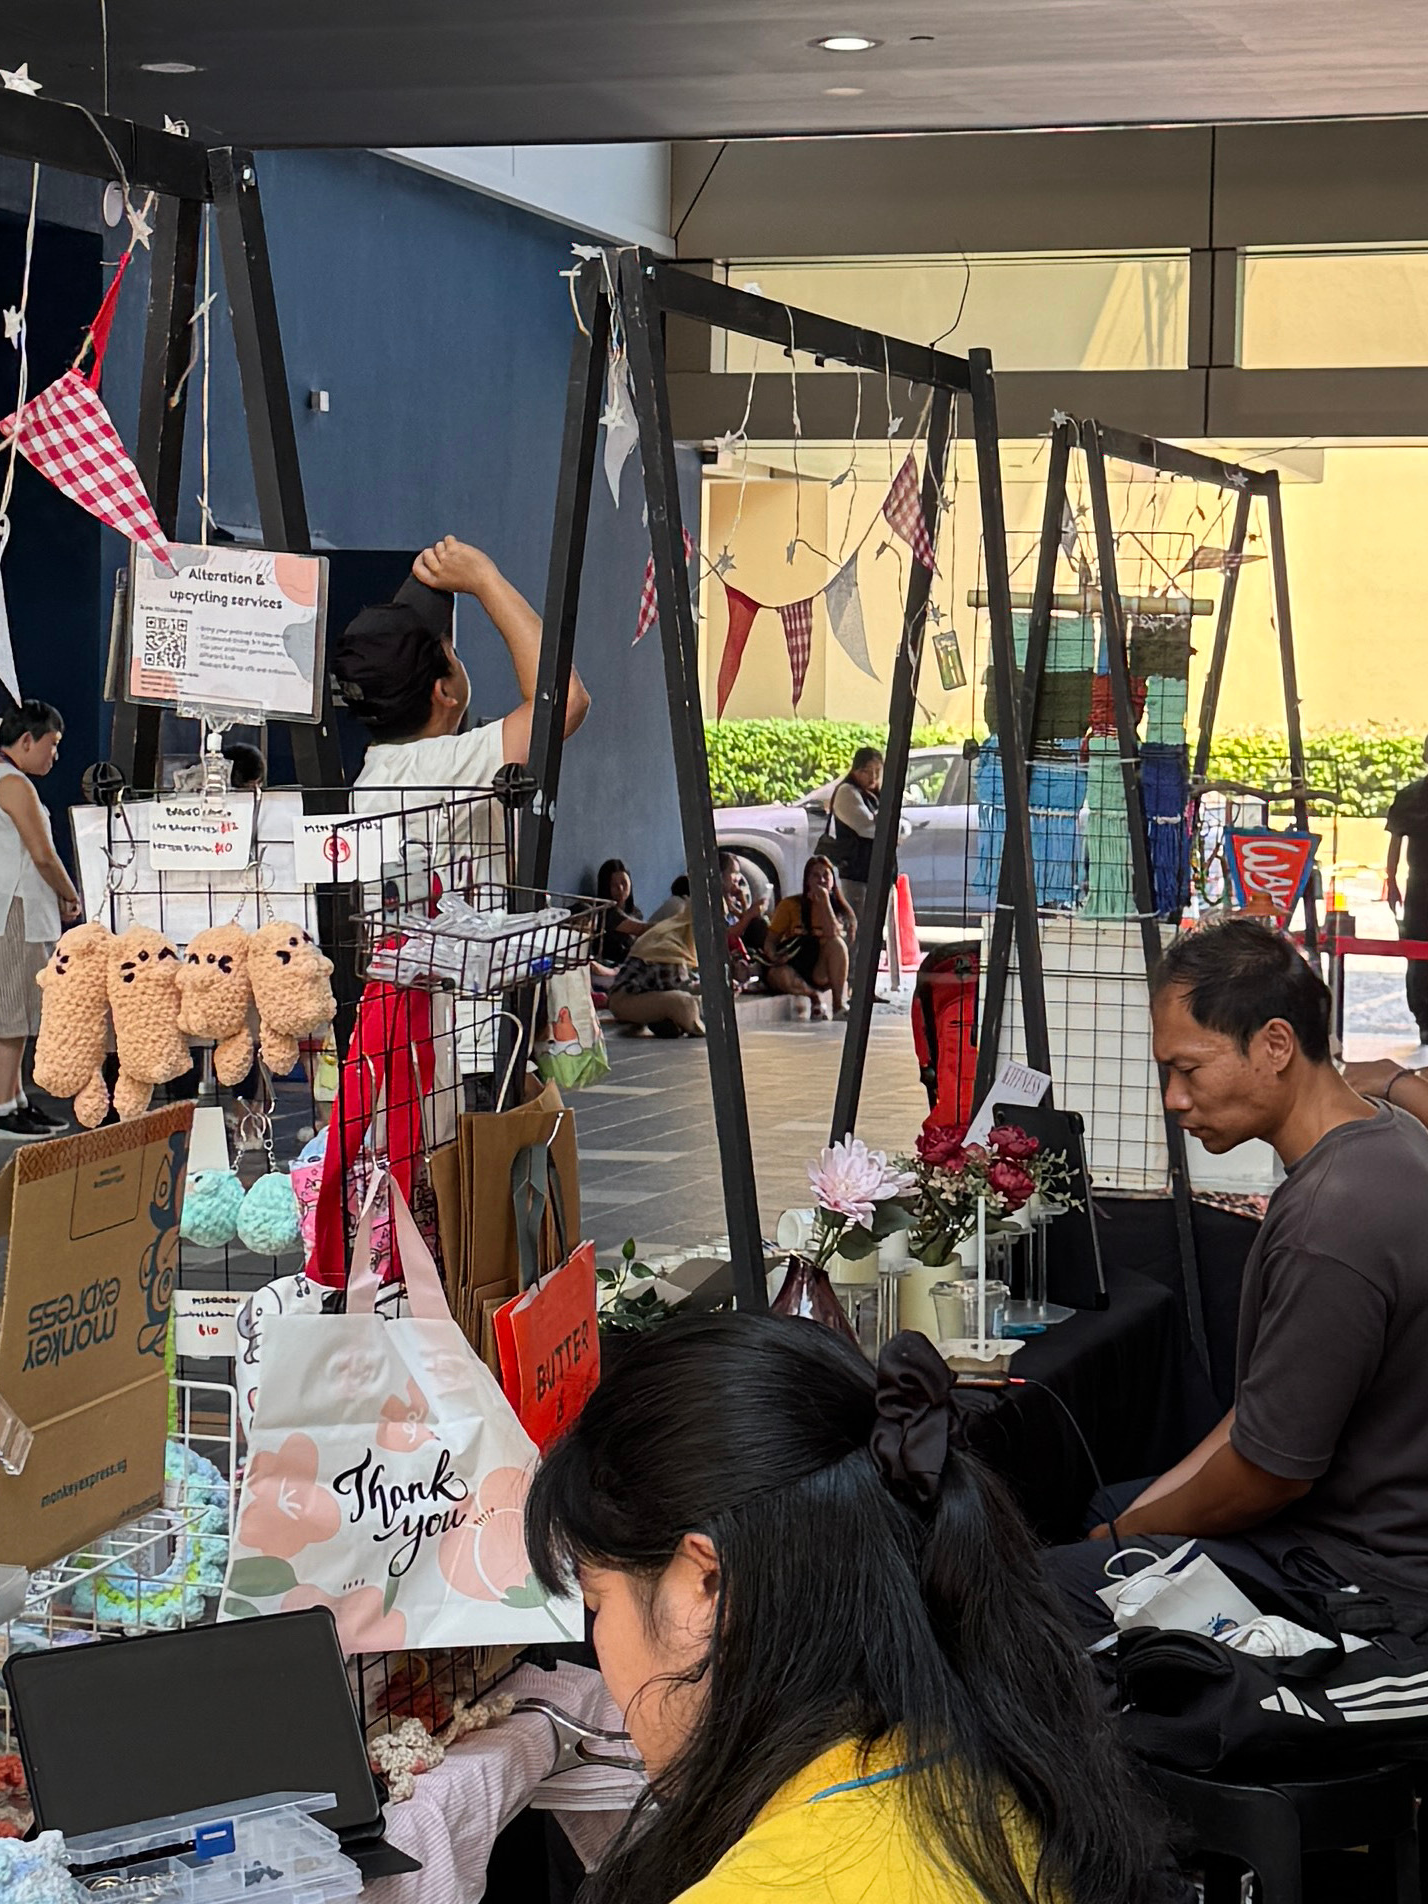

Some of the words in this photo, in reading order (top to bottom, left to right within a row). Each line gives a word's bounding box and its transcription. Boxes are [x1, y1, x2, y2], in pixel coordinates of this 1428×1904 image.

[169, 590, 228, 608] upcycling
[231, 595, 283, 610] services
[188, 568, 252, 586] Alteration
[256, 572, 266, 586] &
[21, 1307, 118, 1373] monkey
[27, 1277, 121, 1337] express
[536, 1319, 590, 1402] BUTTER
[333, 1448, 469, 1529] Thank
[373, 1507, 467, 1578] you
